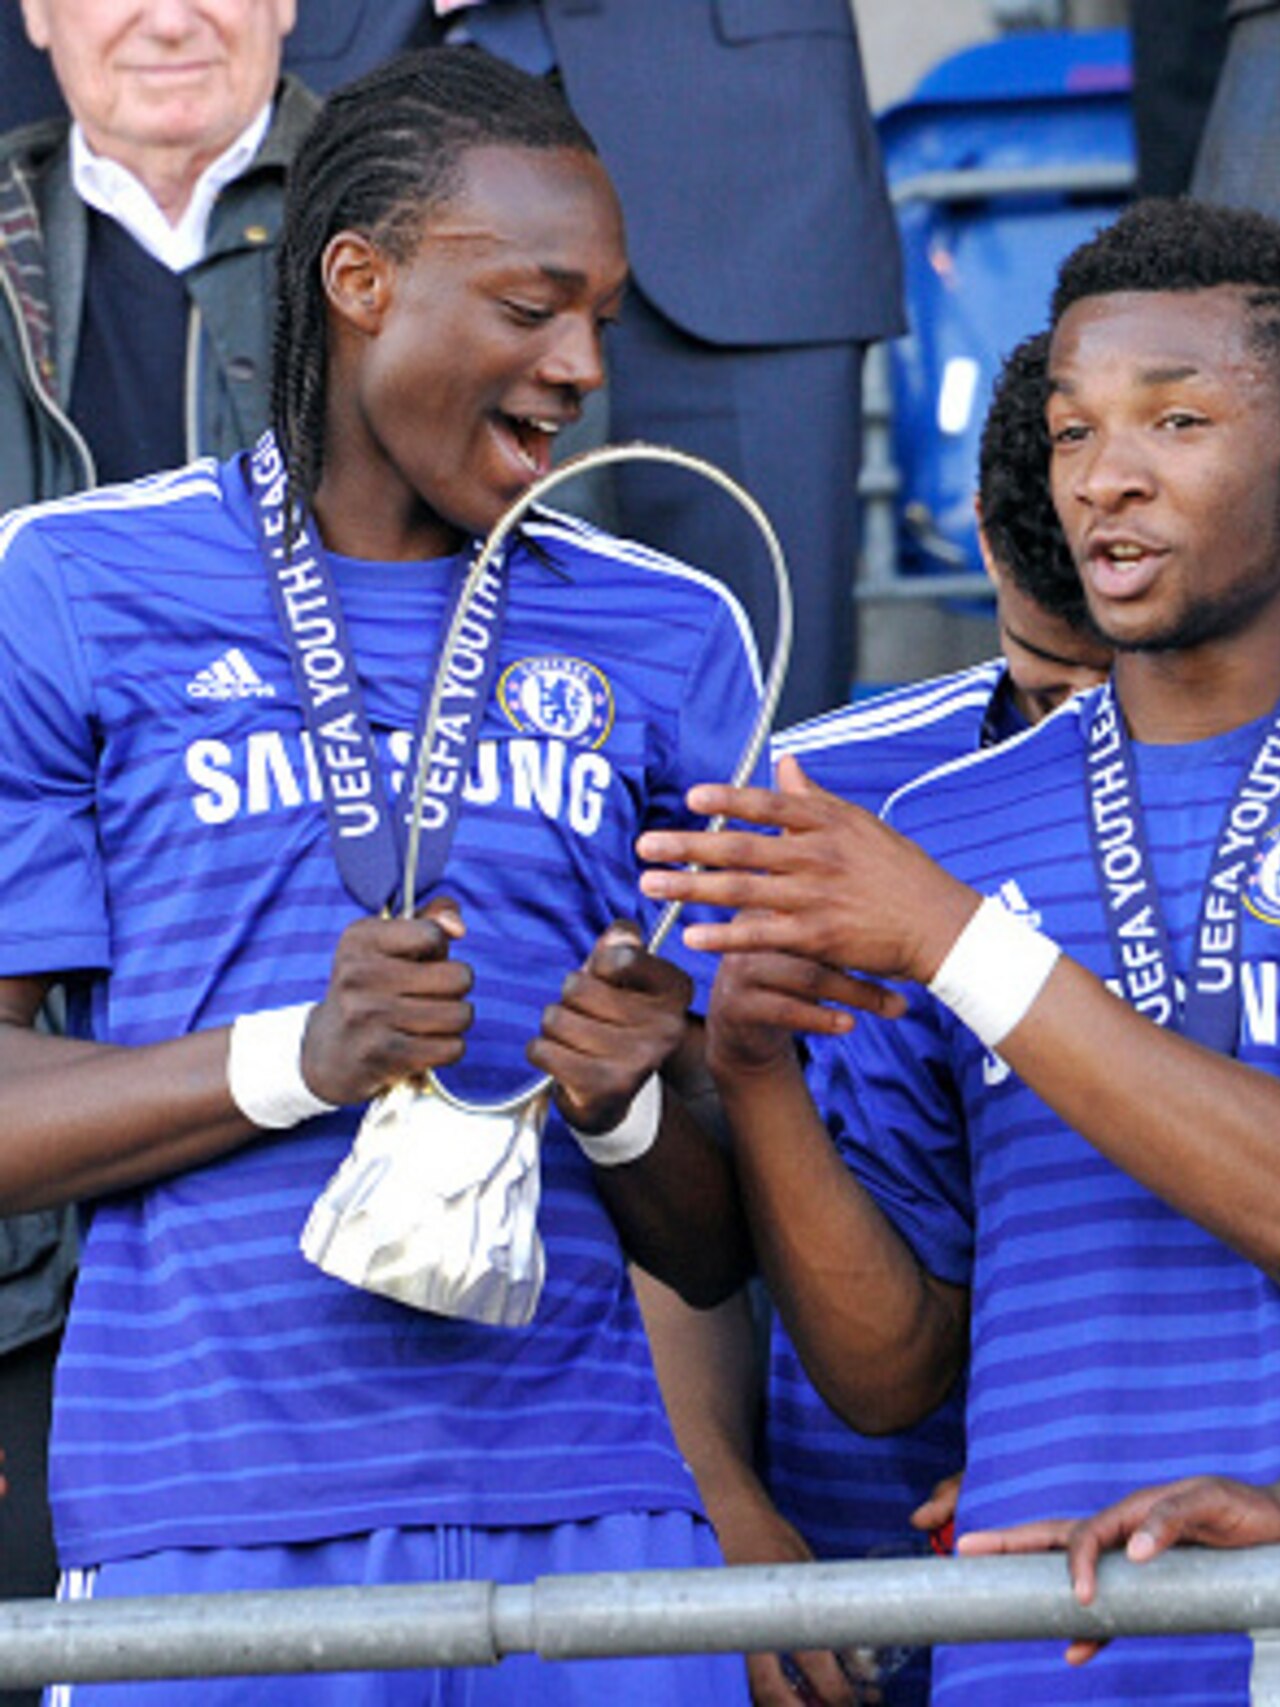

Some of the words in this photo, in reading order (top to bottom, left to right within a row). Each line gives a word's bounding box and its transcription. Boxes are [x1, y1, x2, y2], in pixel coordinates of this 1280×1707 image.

[278, 557, 350, 707] YOUTH
[320, 712, 379, 837] UEFA
[1089, 761, 1146, 909] YOUTH
[1197, 862, 1246, 993] UEFA
